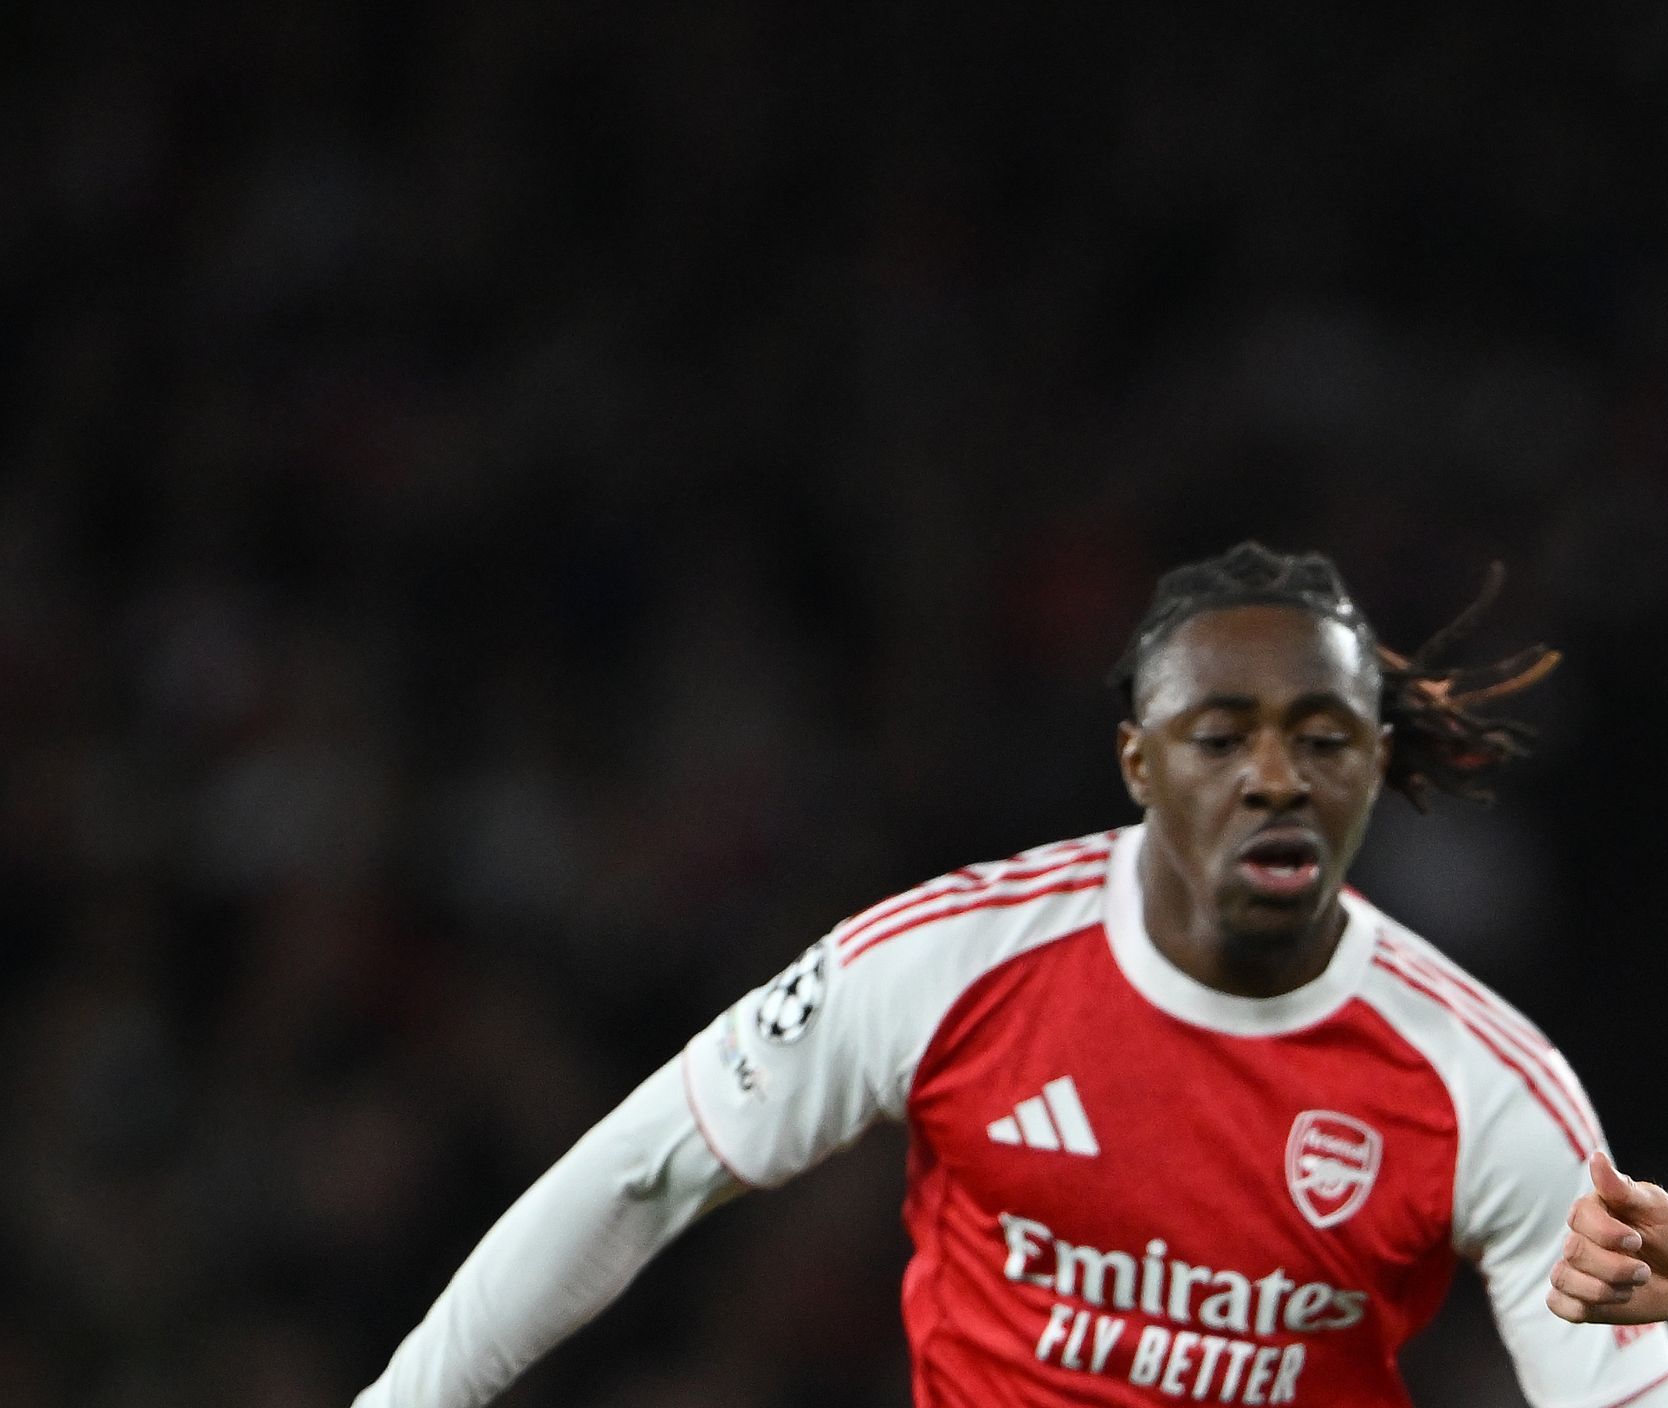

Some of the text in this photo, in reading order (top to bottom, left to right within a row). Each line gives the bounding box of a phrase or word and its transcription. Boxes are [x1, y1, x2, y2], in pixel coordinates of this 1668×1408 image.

[998, 1211, 1369, 1337] Emirates
[1035, 1302, 1307, 1408] FLY BETTER
